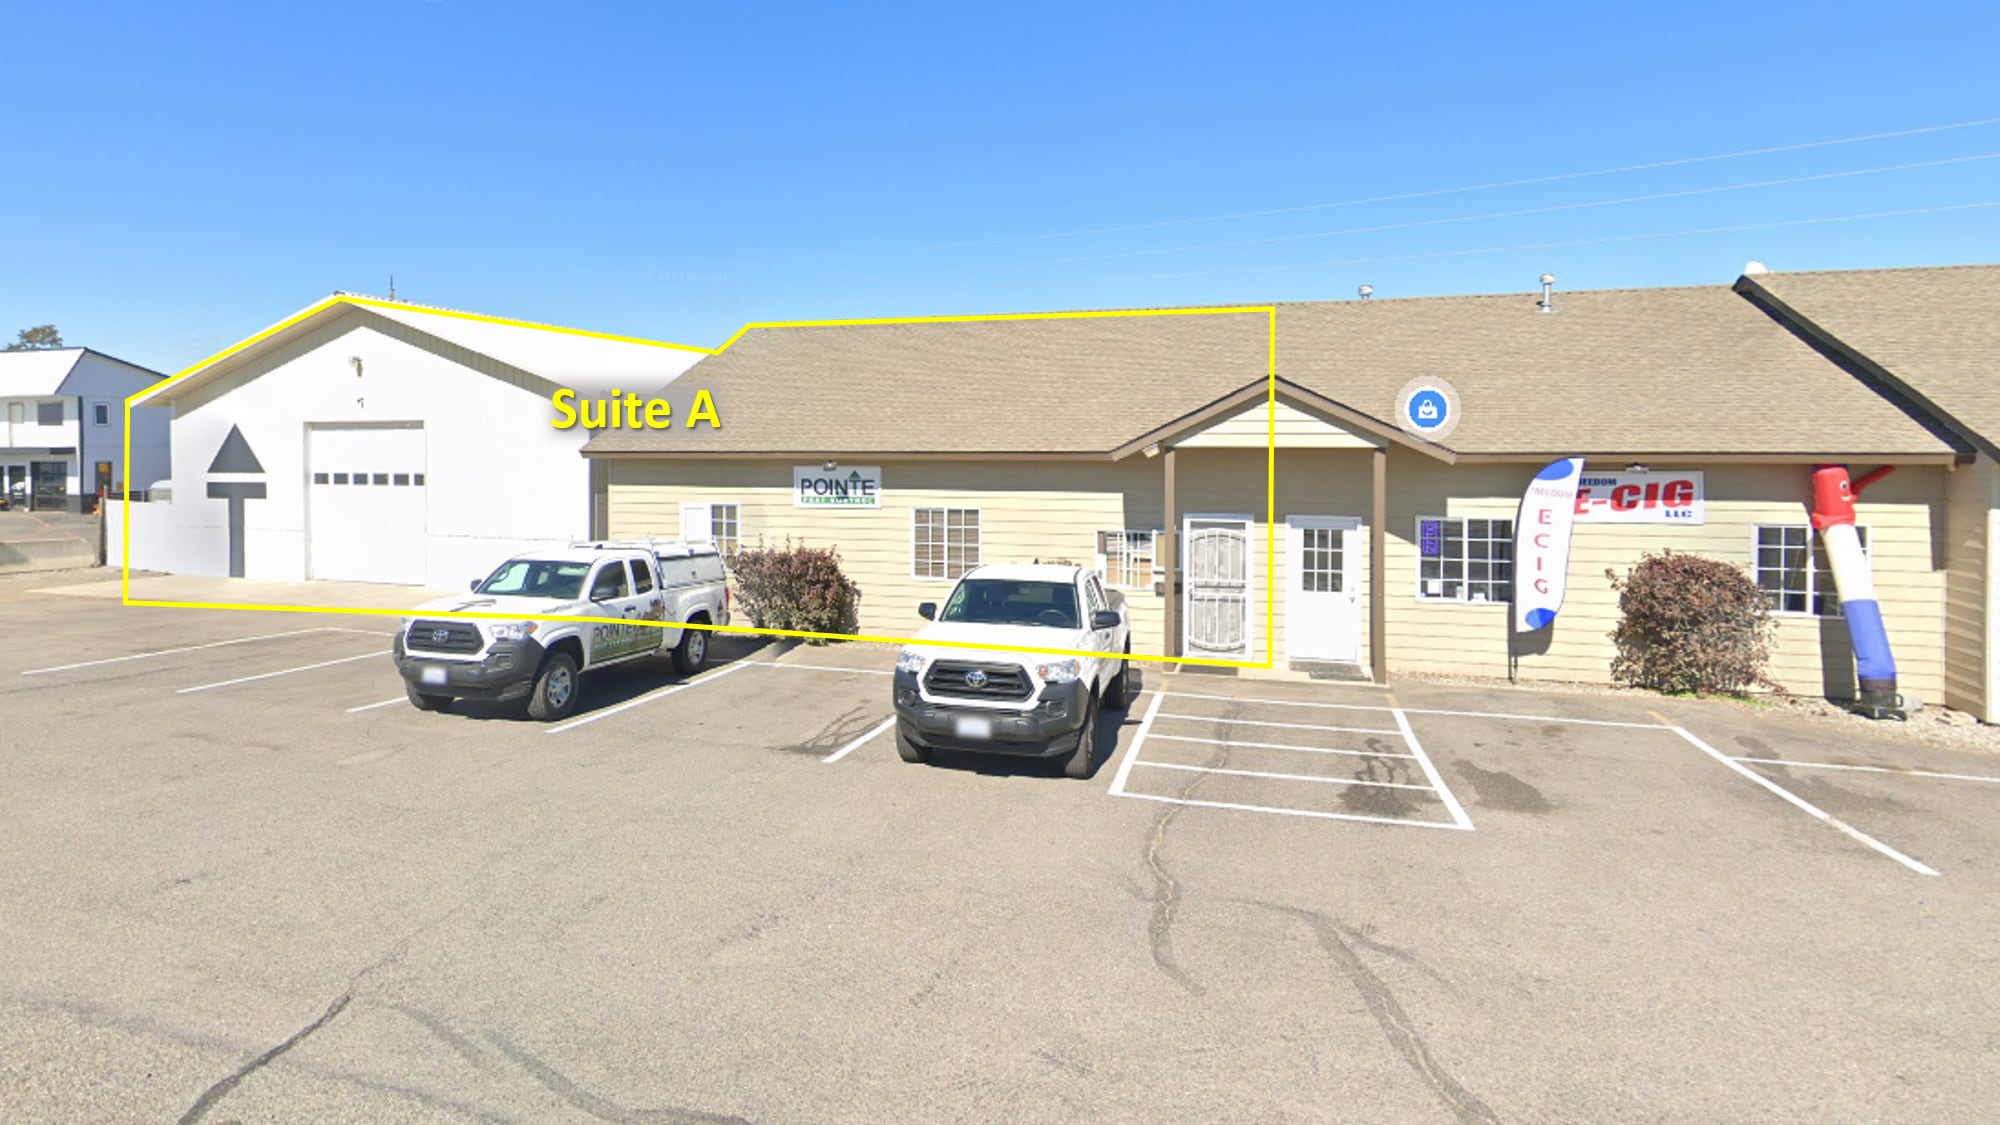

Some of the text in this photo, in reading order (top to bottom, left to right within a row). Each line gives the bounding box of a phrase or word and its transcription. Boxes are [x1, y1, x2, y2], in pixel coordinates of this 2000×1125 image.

[801, 475, 875, 496] POINTE
[1579, 478, 1616, 486] EEDOM
[1574, 480, 1694, 515] E-CIG
[1665, 510, 1692, 518] LLC
